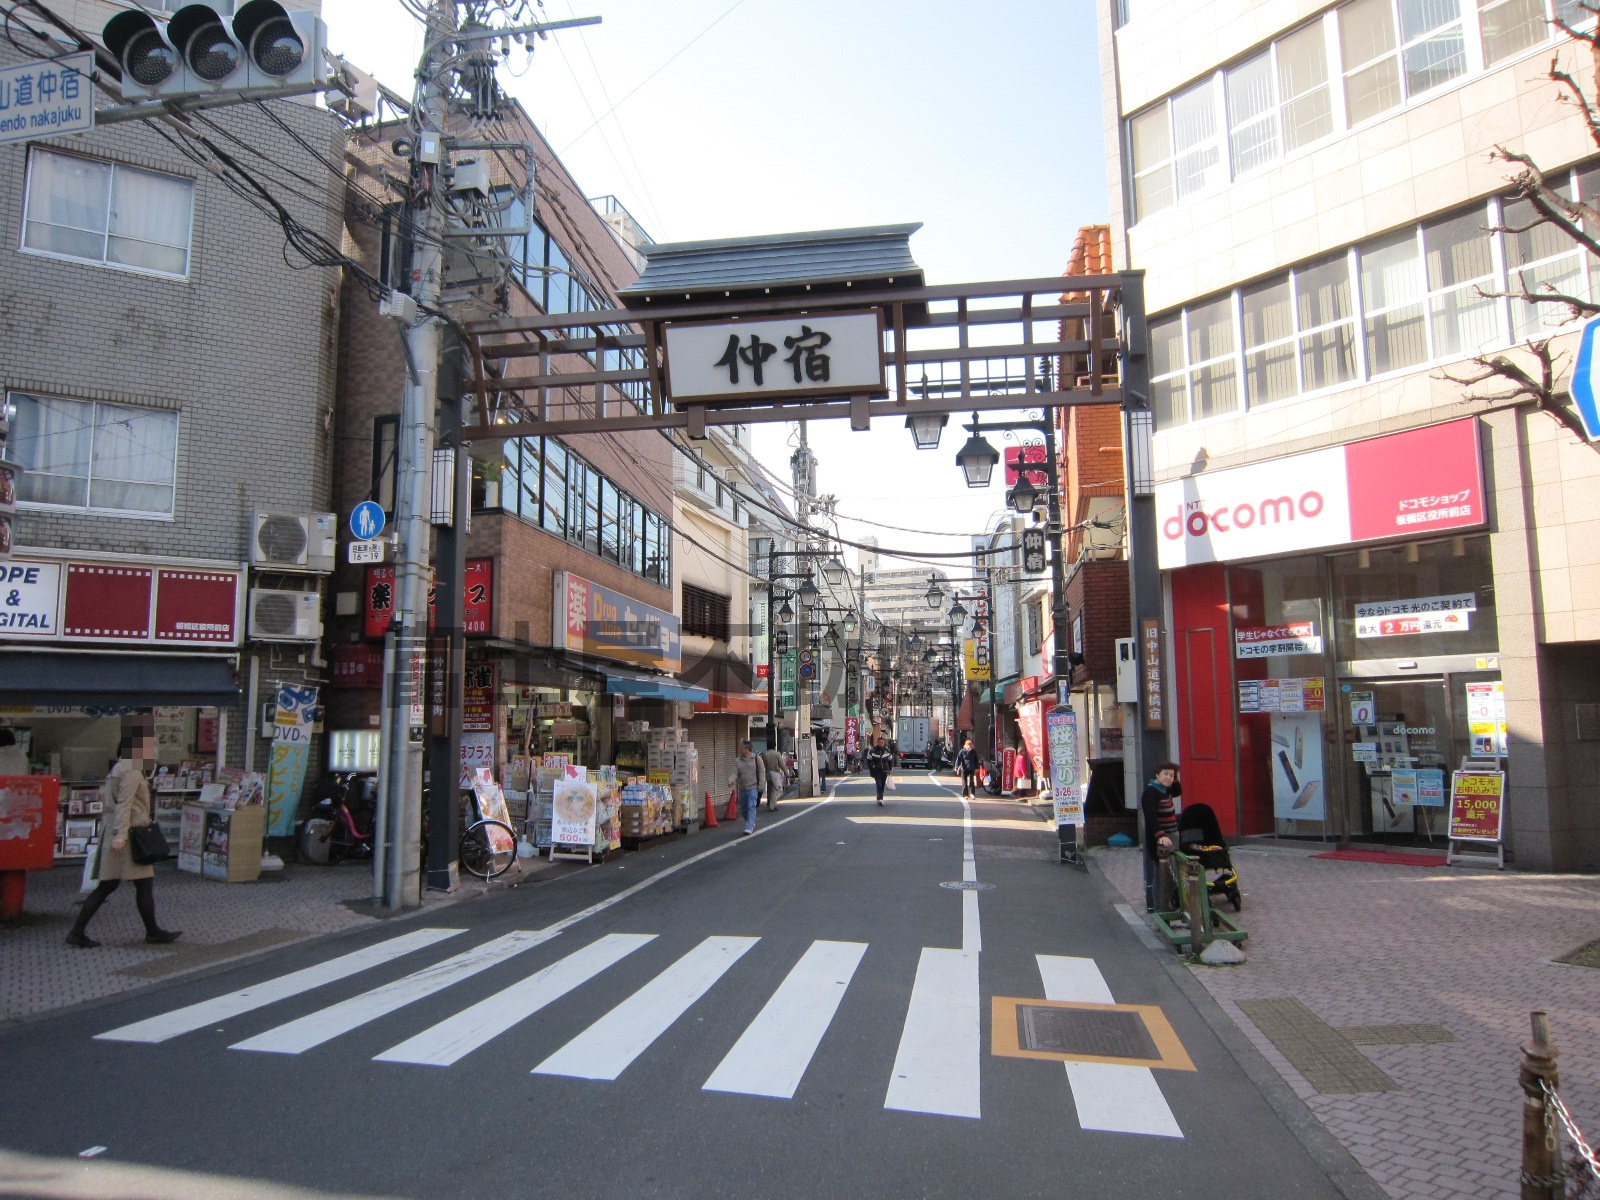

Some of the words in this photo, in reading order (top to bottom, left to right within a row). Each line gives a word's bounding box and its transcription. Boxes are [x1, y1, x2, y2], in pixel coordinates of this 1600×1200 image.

[30, 105, 81, 127] nakajuku
[713, 325, 831, 386] 仲宿
[1399, 489, 1471, 512] ドコモショップ
[1163, 490, 1324, 541] docomo
[1396, 504, 1472, 526] 板橋区役所前店
[1024, 532, 1044, 571] 仲宿
[6, 589, 21, 606] &
[593, 592, 617, 622] Drug
[1146, 628, 1161, 719] 旧中山道板橋宿
[1394, 725, 1435, 735] docomo
[1462, 778, 1496, 786] ドコモ光
[1457, 800, 1497, 809] 15,000
